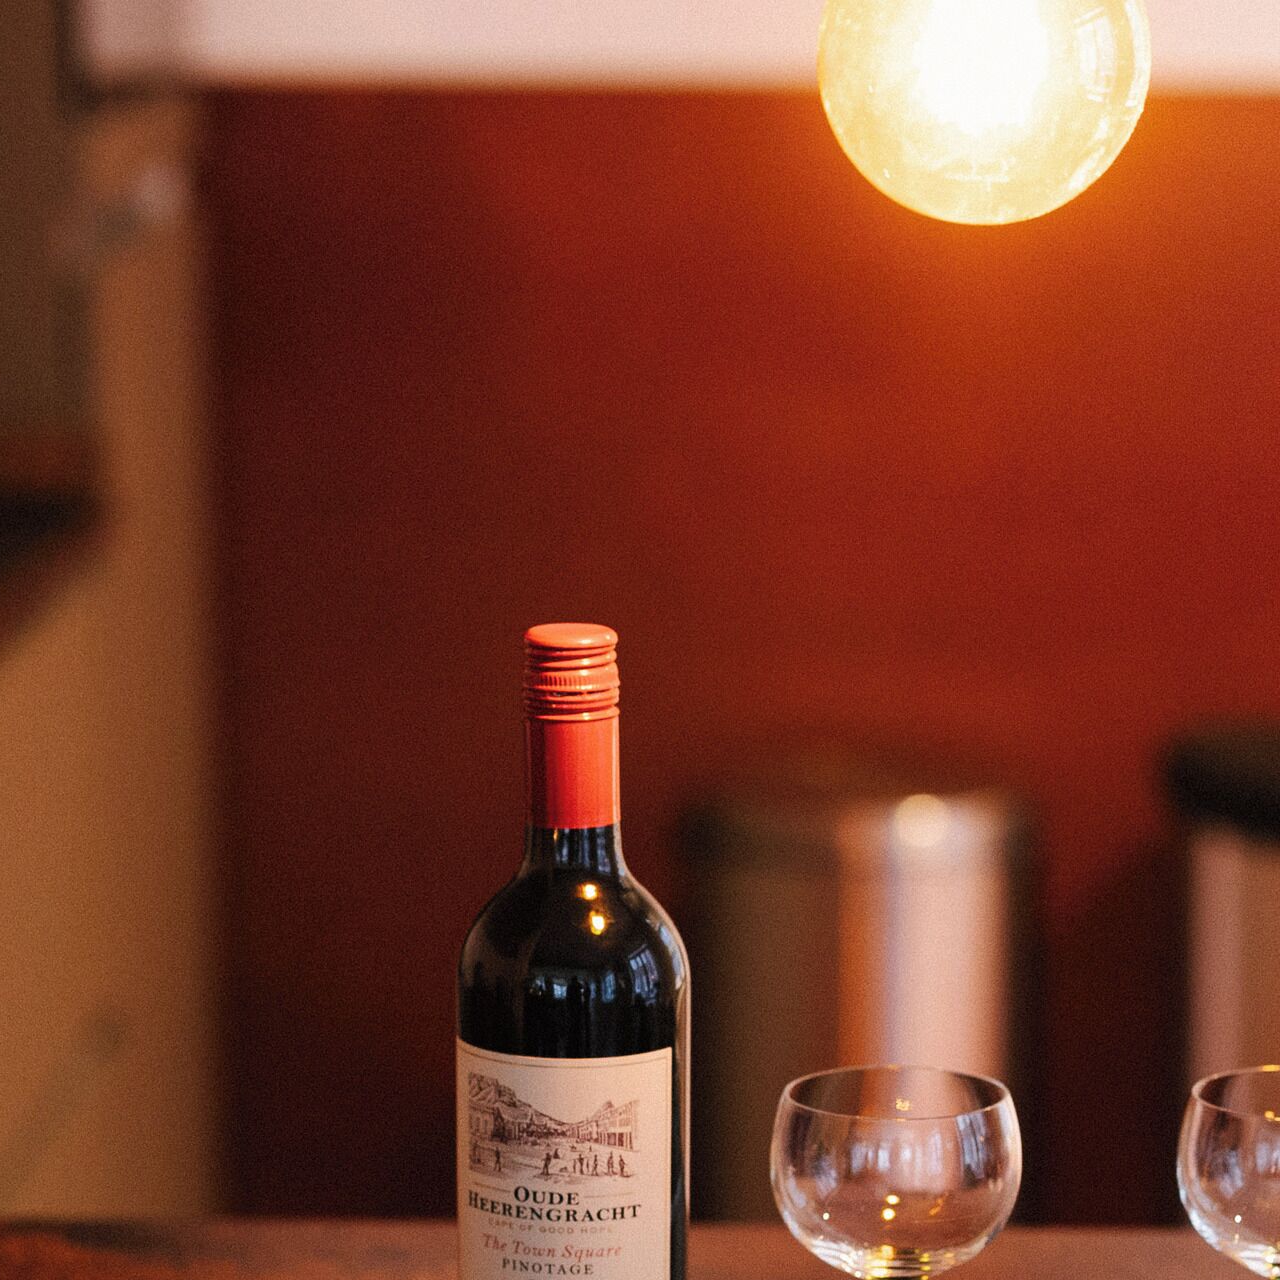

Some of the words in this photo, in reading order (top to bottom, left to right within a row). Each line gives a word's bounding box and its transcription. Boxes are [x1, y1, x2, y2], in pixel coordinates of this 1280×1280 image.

[468, 1189, 642, 1223] HEERENGRACHT
[513, 1185, 580, 1206] OUDE
[538, 1225, 575, 1235] GOOD
[481, 1232, 508, 1250] The
[513, 1238, 556, 1259] Town
[560, 1244, 623, 1262] Square
[501, 1257, 595, 1276] PINOTAGE
